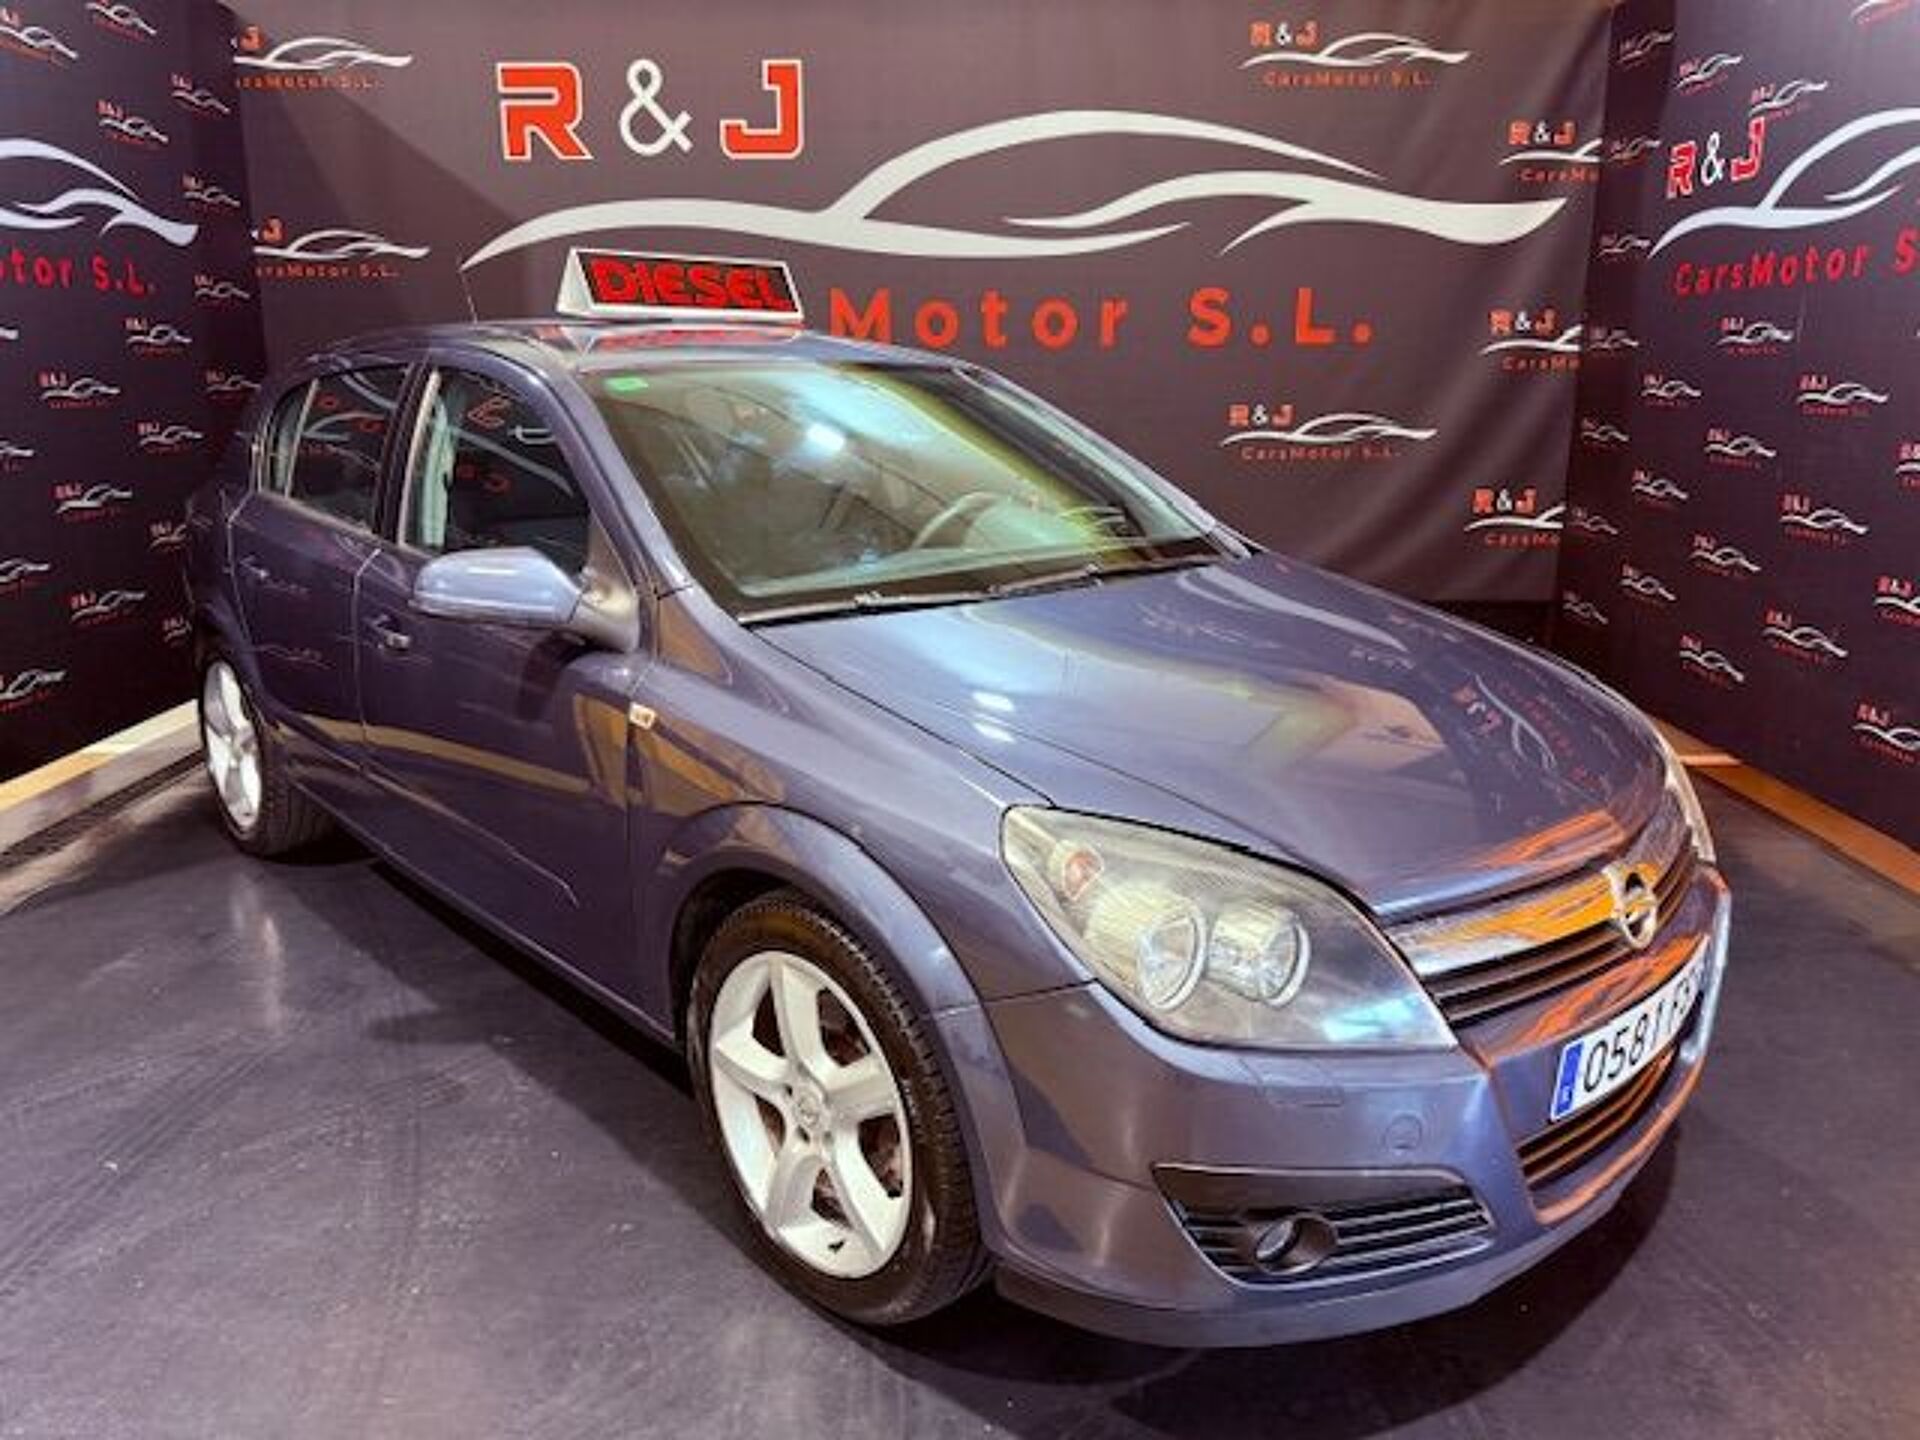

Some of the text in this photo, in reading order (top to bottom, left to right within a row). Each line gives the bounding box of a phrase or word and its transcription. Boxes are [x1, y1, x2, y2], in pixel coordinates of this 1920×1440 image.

[0, 246, 72, 289] tor
[590, 255, 795, 312] DIESEL
[1673, 245, 1869, 297] CarsMotor
[829, 286, 1373, 349] Motor S.L.
